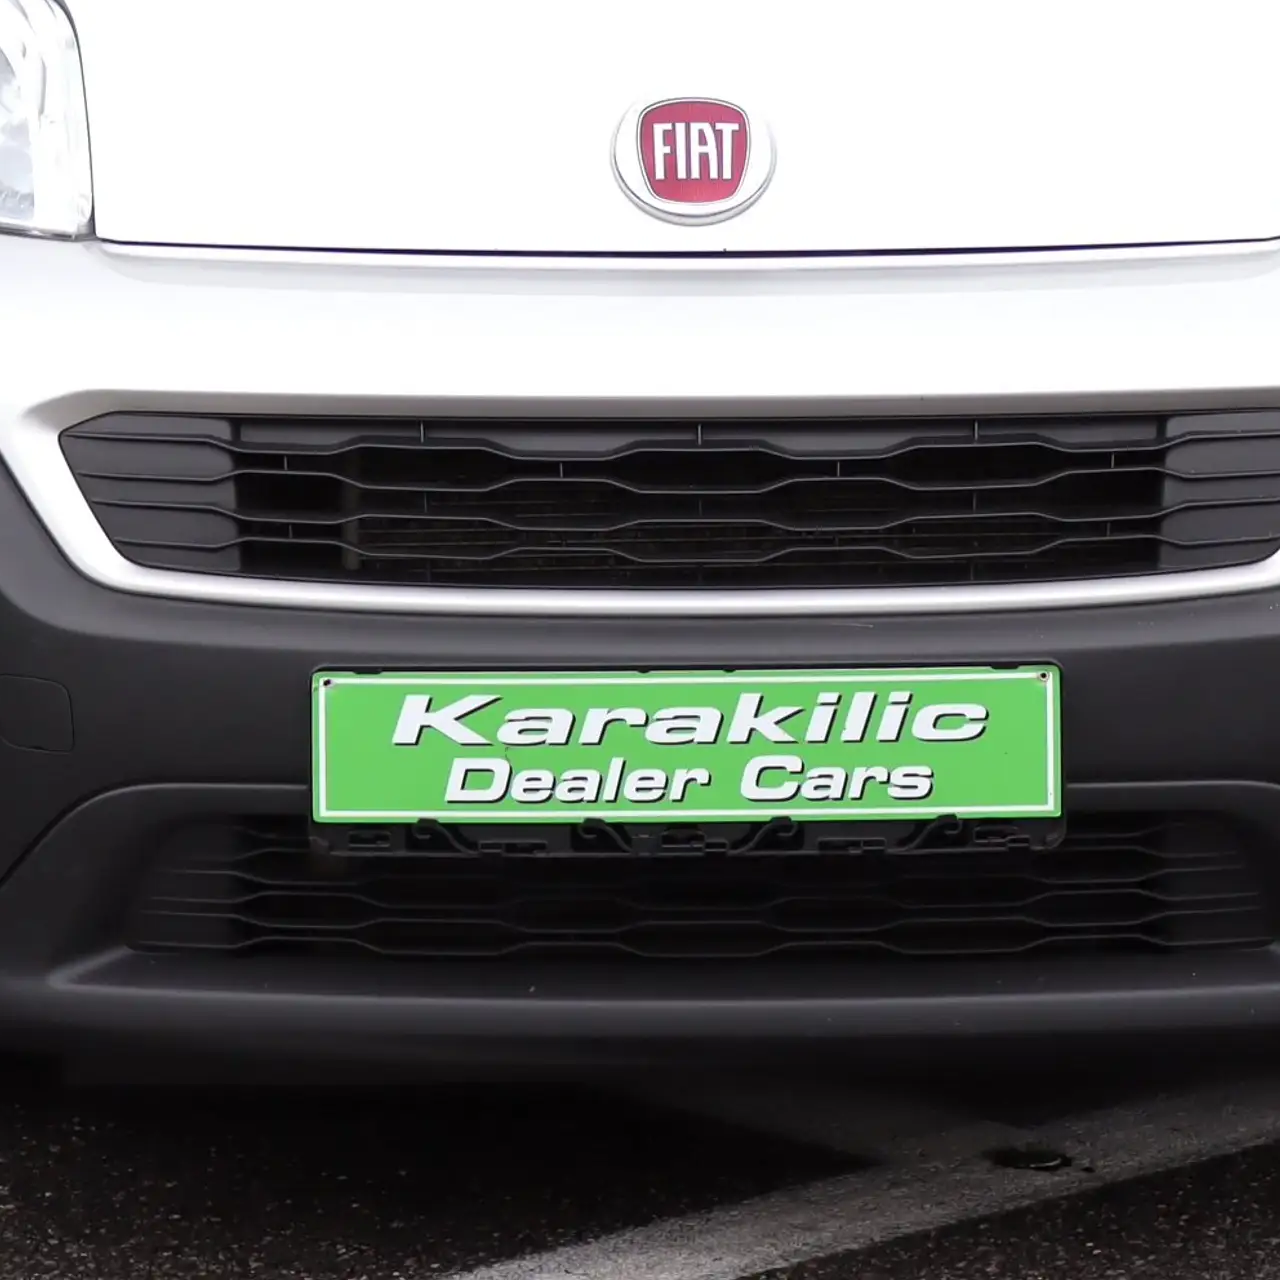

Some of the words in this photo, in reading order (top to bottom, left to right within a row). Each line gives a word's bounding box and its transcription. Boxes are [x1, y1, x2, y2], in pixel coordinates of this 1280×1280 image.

[652, 122, 740, 181] FIAT
[391, 691, 990, 746] Karakilic
[444, 756, 712, 805] Dealer
[739, 754, 934, 803] Cars
